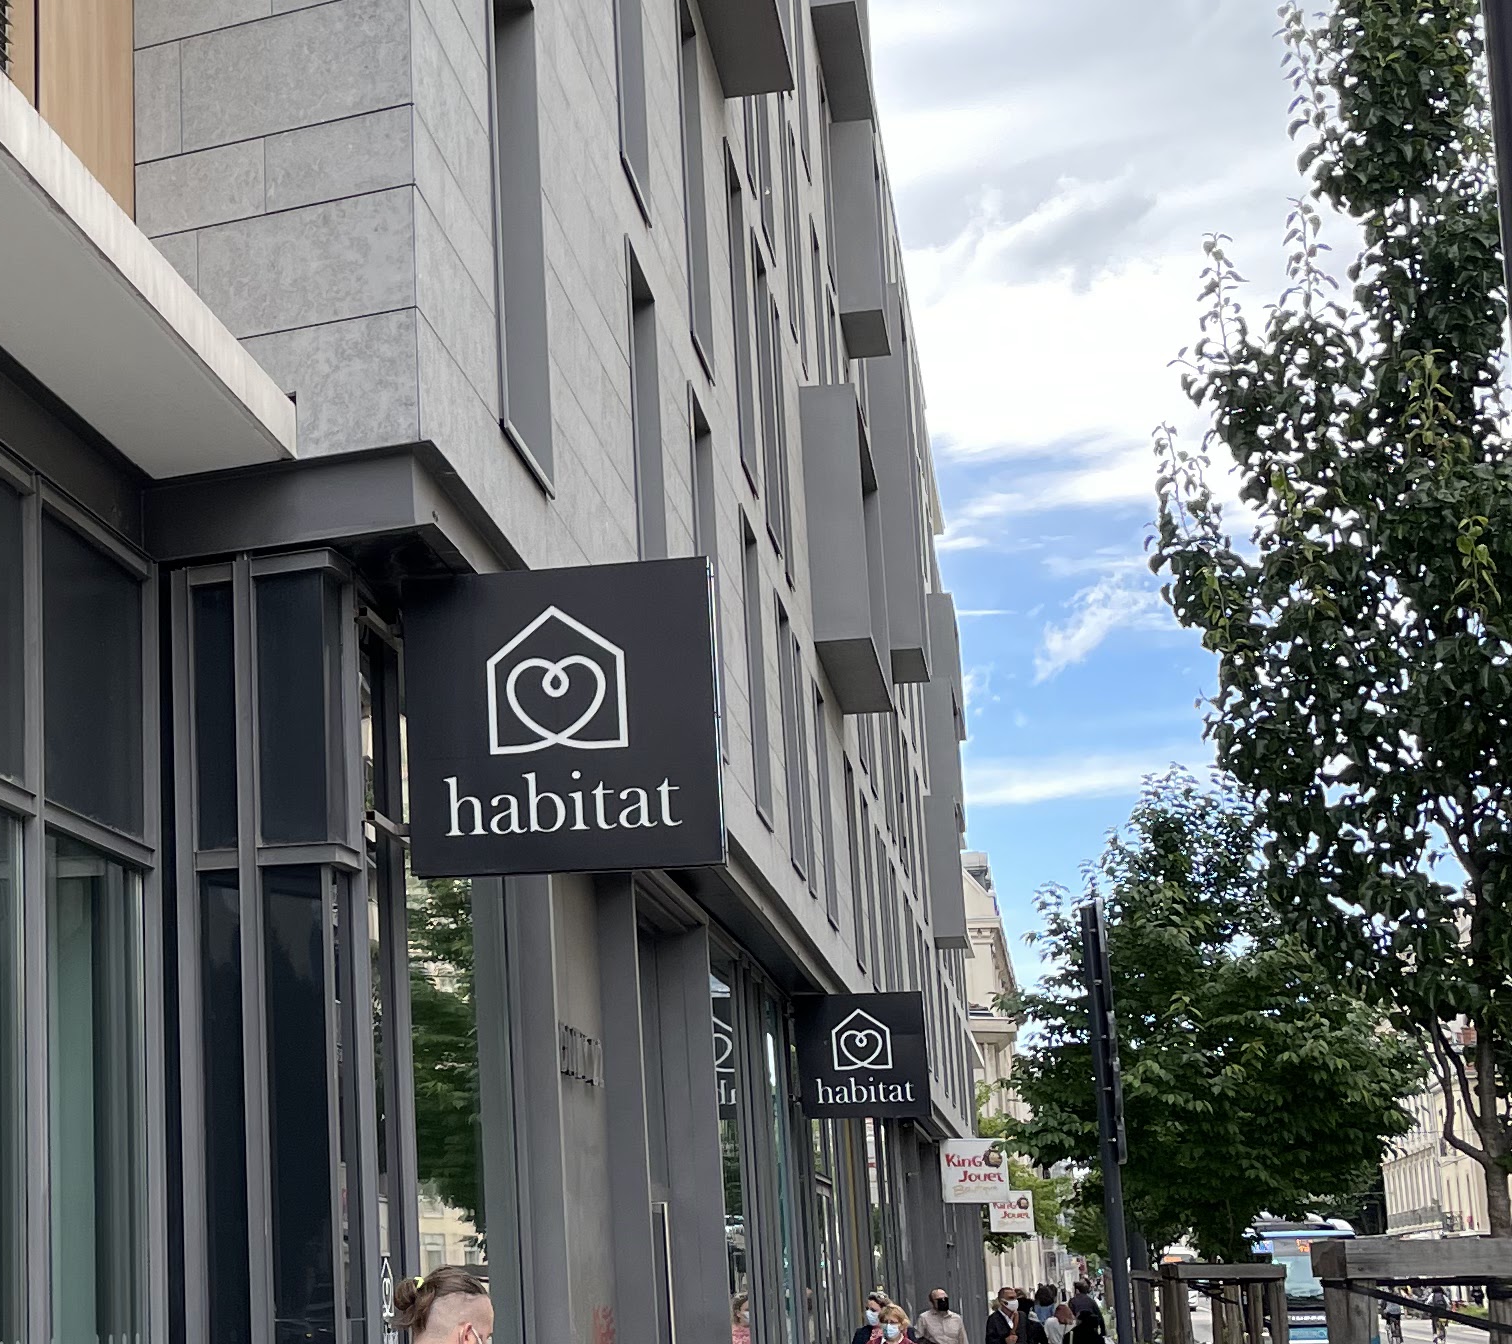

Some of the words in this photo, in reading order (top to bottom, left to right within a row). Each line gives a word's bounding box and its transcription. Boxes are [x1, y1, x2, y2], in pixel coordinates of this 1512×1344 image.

[443, 770, 683, 837] habitat
[815, 1076, 916, 1105] habitat
[958, 1170, 1004, 1182] Jouet
